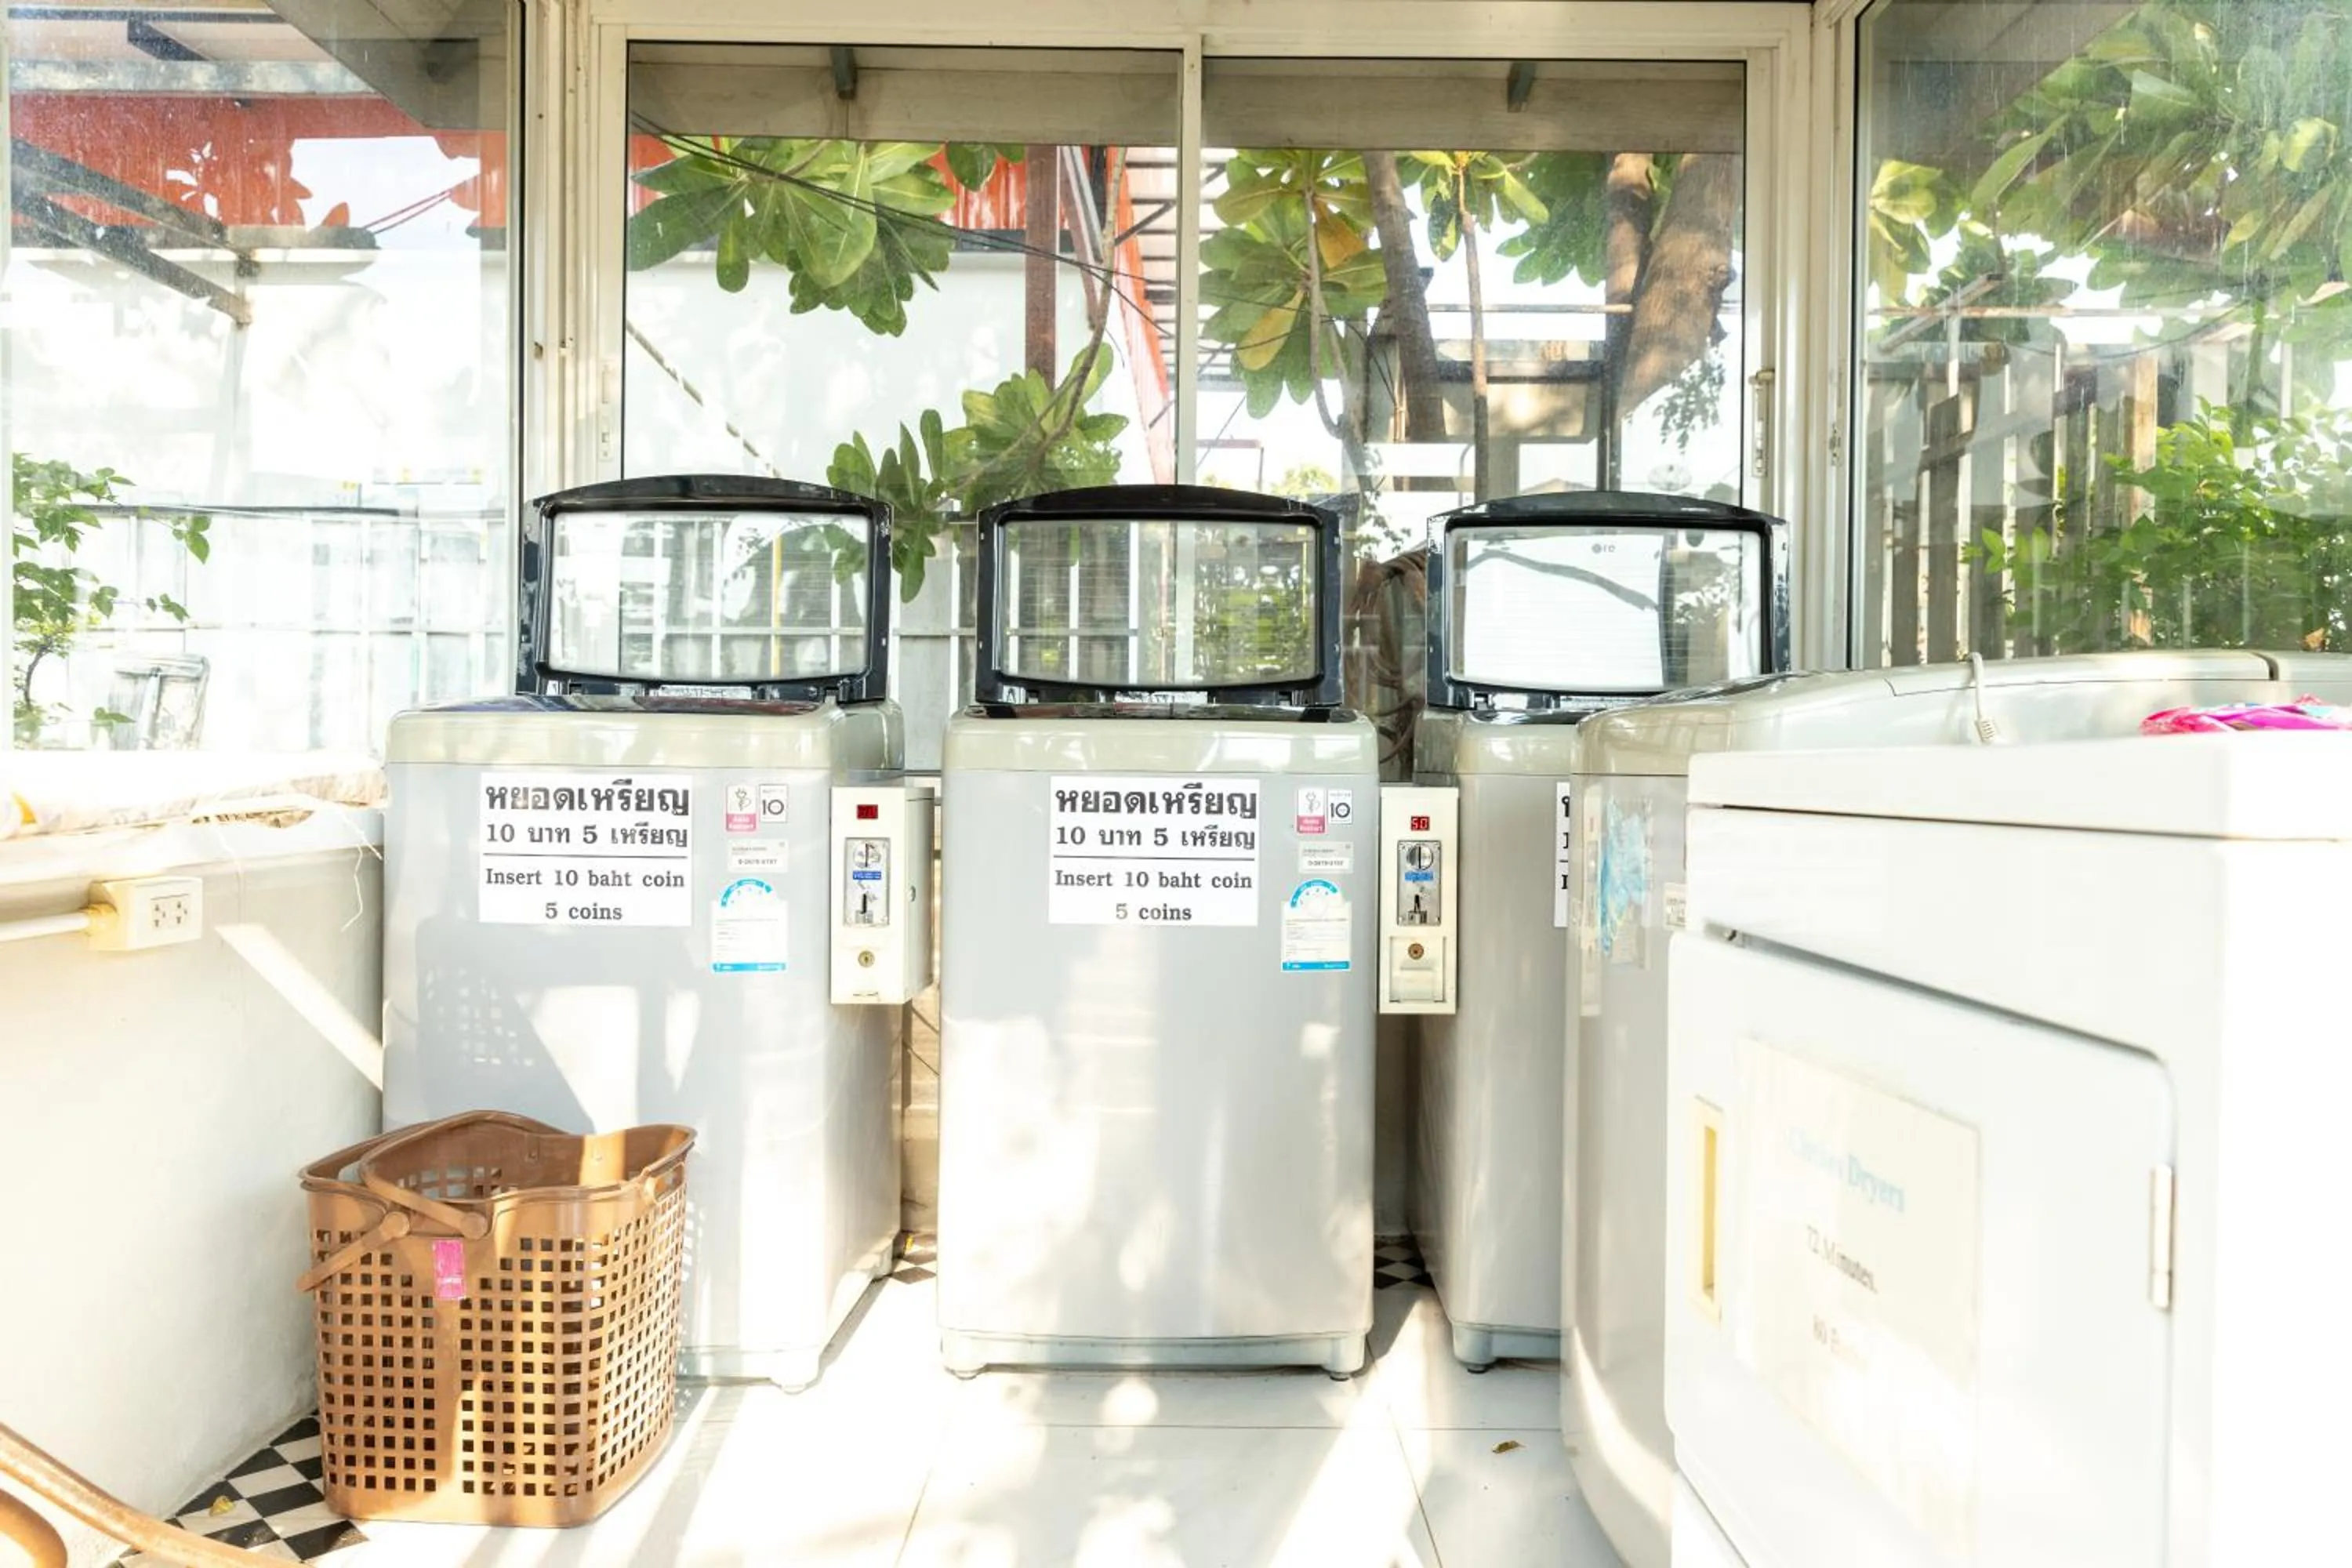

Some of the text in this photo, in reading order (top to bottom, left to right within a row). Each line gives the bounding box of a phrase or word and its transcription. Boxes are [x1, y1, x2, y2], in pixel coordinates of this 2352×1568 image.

[485, 778, 689, 816] หยอดเหรียญ
[1054, 782, 1258, 820] หยอดเหรียญ
[761, 798, 785, 816] 10
[1330, 802, 1351, 818] 10
[487, 821, 688, 848] 10 บาท 5 เหรียญ
[1056, 824, 1255, 851] 10 บาท 5 เหรียญ
[486, 868, 684, 887] Insert 10 baht coin
[1054, 869, 1253, 889] Insert 10 baht coin
[545, 902, 622, 920] 5 coins
[1116, 902, 1192, 921] 5 coins
